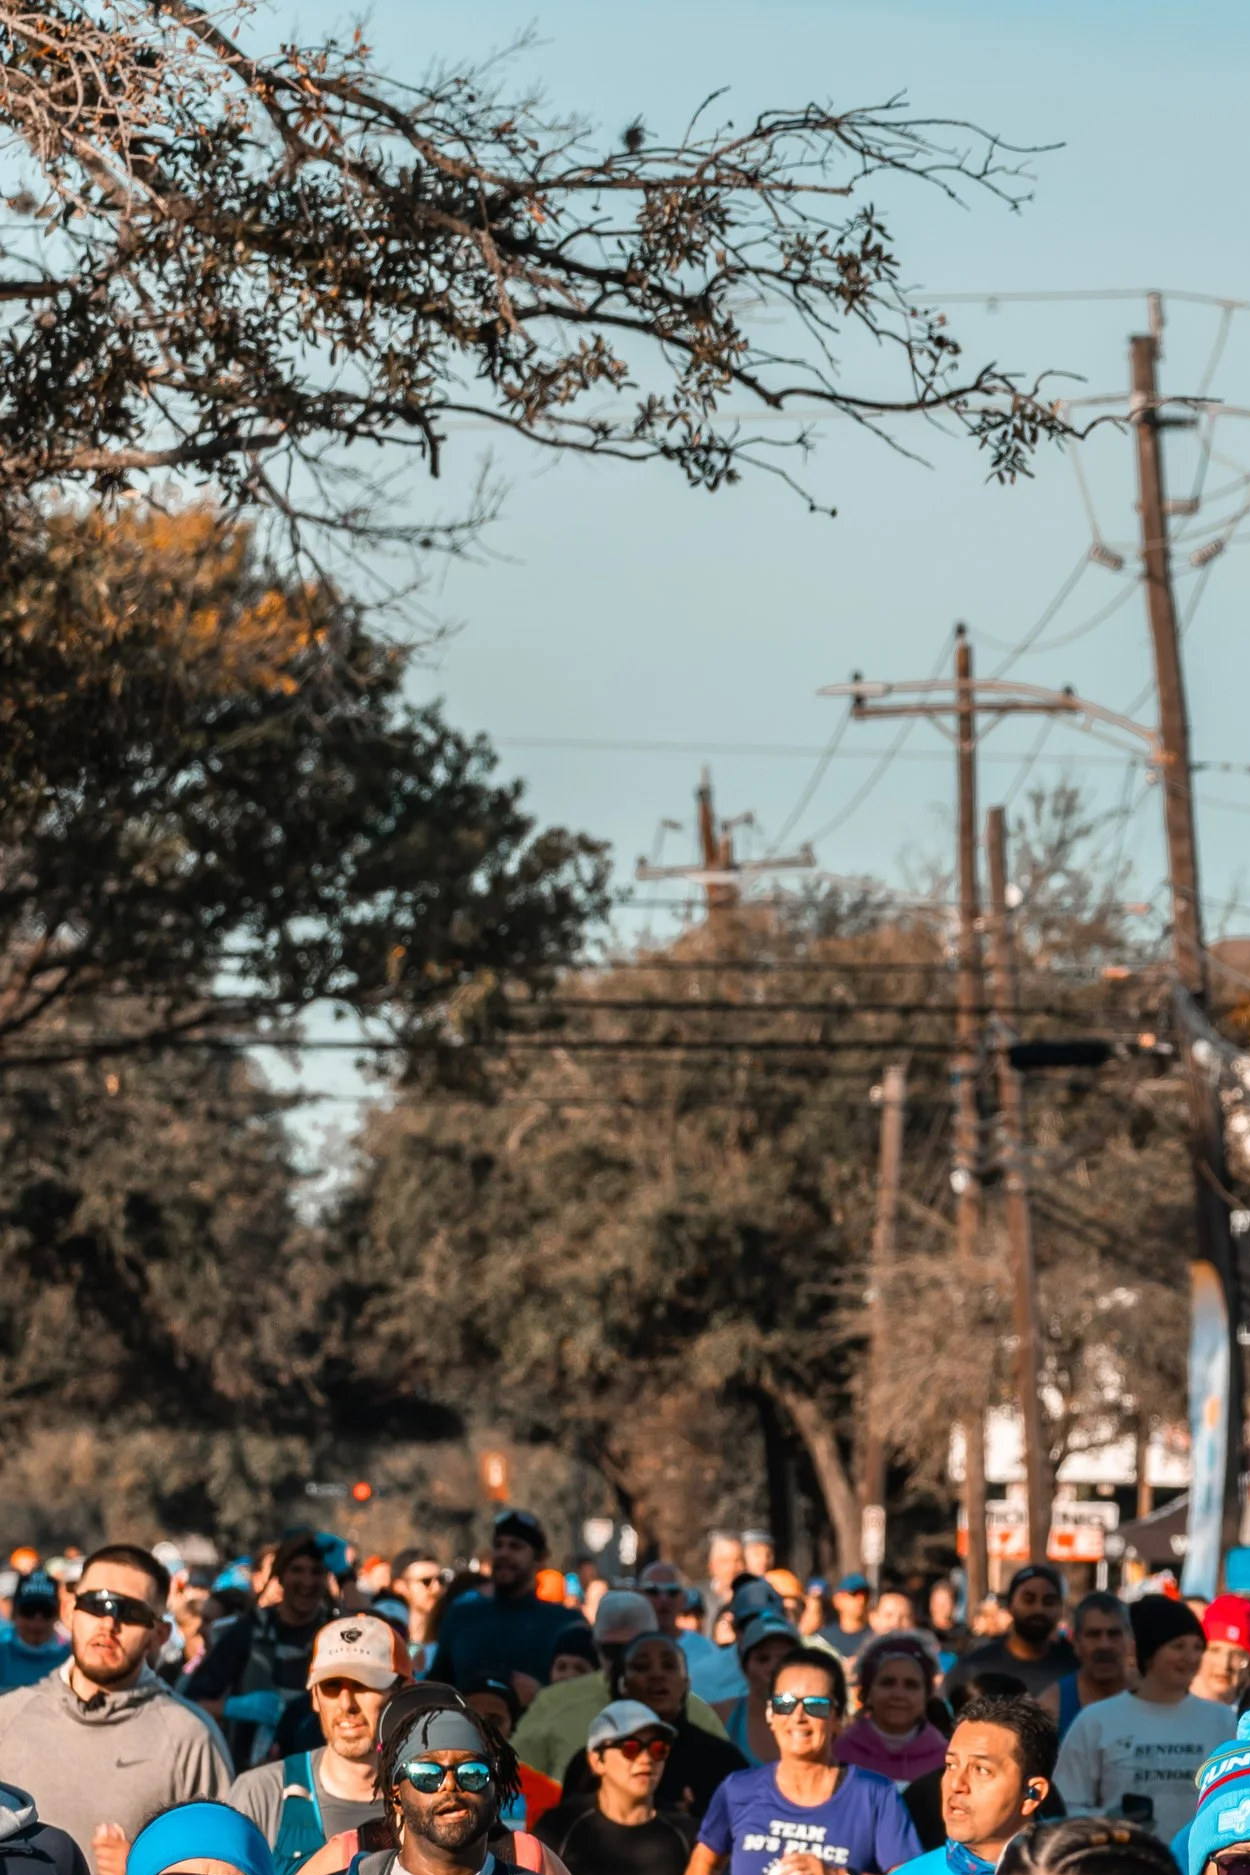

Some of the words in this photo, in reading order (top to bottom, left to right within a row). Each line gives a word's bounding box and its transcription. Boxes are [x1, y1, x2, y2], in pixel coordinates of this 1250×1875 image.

[1134, 1769, 1196, 1783] SENIOR
[769, 1819, 827, 1842] TEAM
[783, 1839, 849, 1864] PLACE
